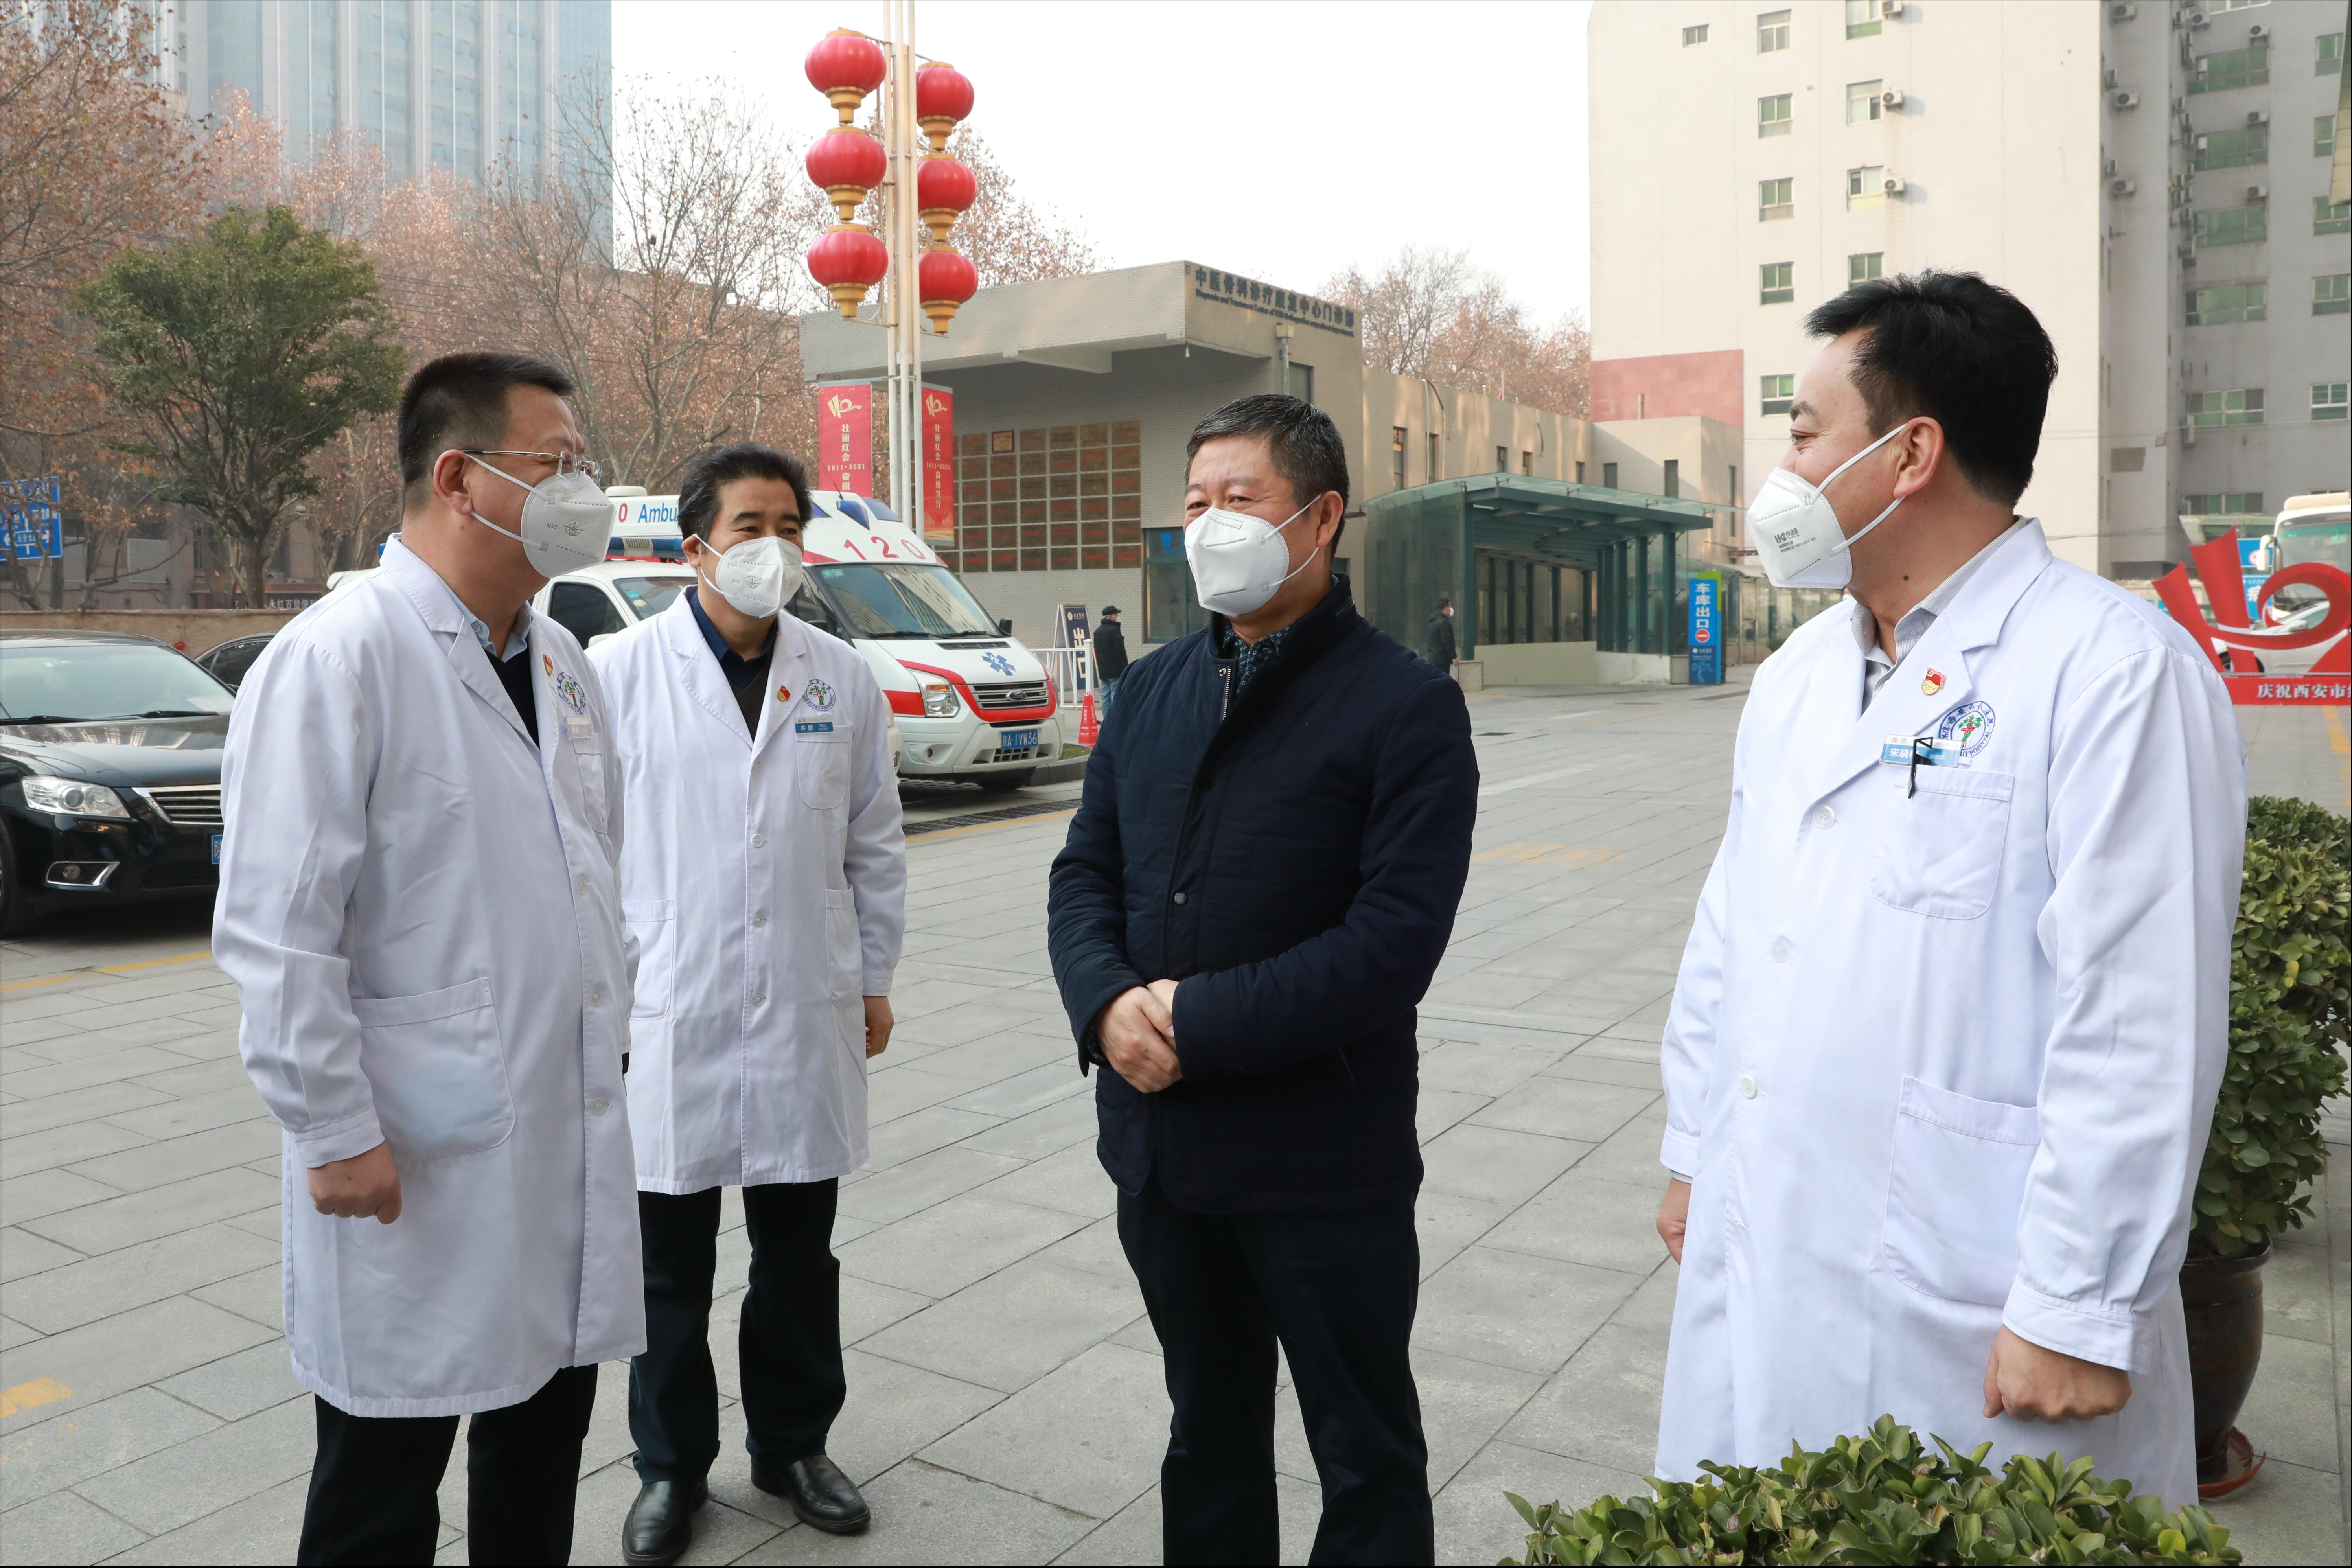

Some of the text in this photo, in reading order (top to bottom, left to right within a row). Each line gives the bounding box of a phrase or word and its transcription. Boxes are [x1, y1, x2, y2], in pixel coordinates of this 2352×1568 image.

[841, 423, 850, 462] 壮丽红会
[843, 536, 926, 560] 120
[1695, 583, 1711, 628] 车库出口
